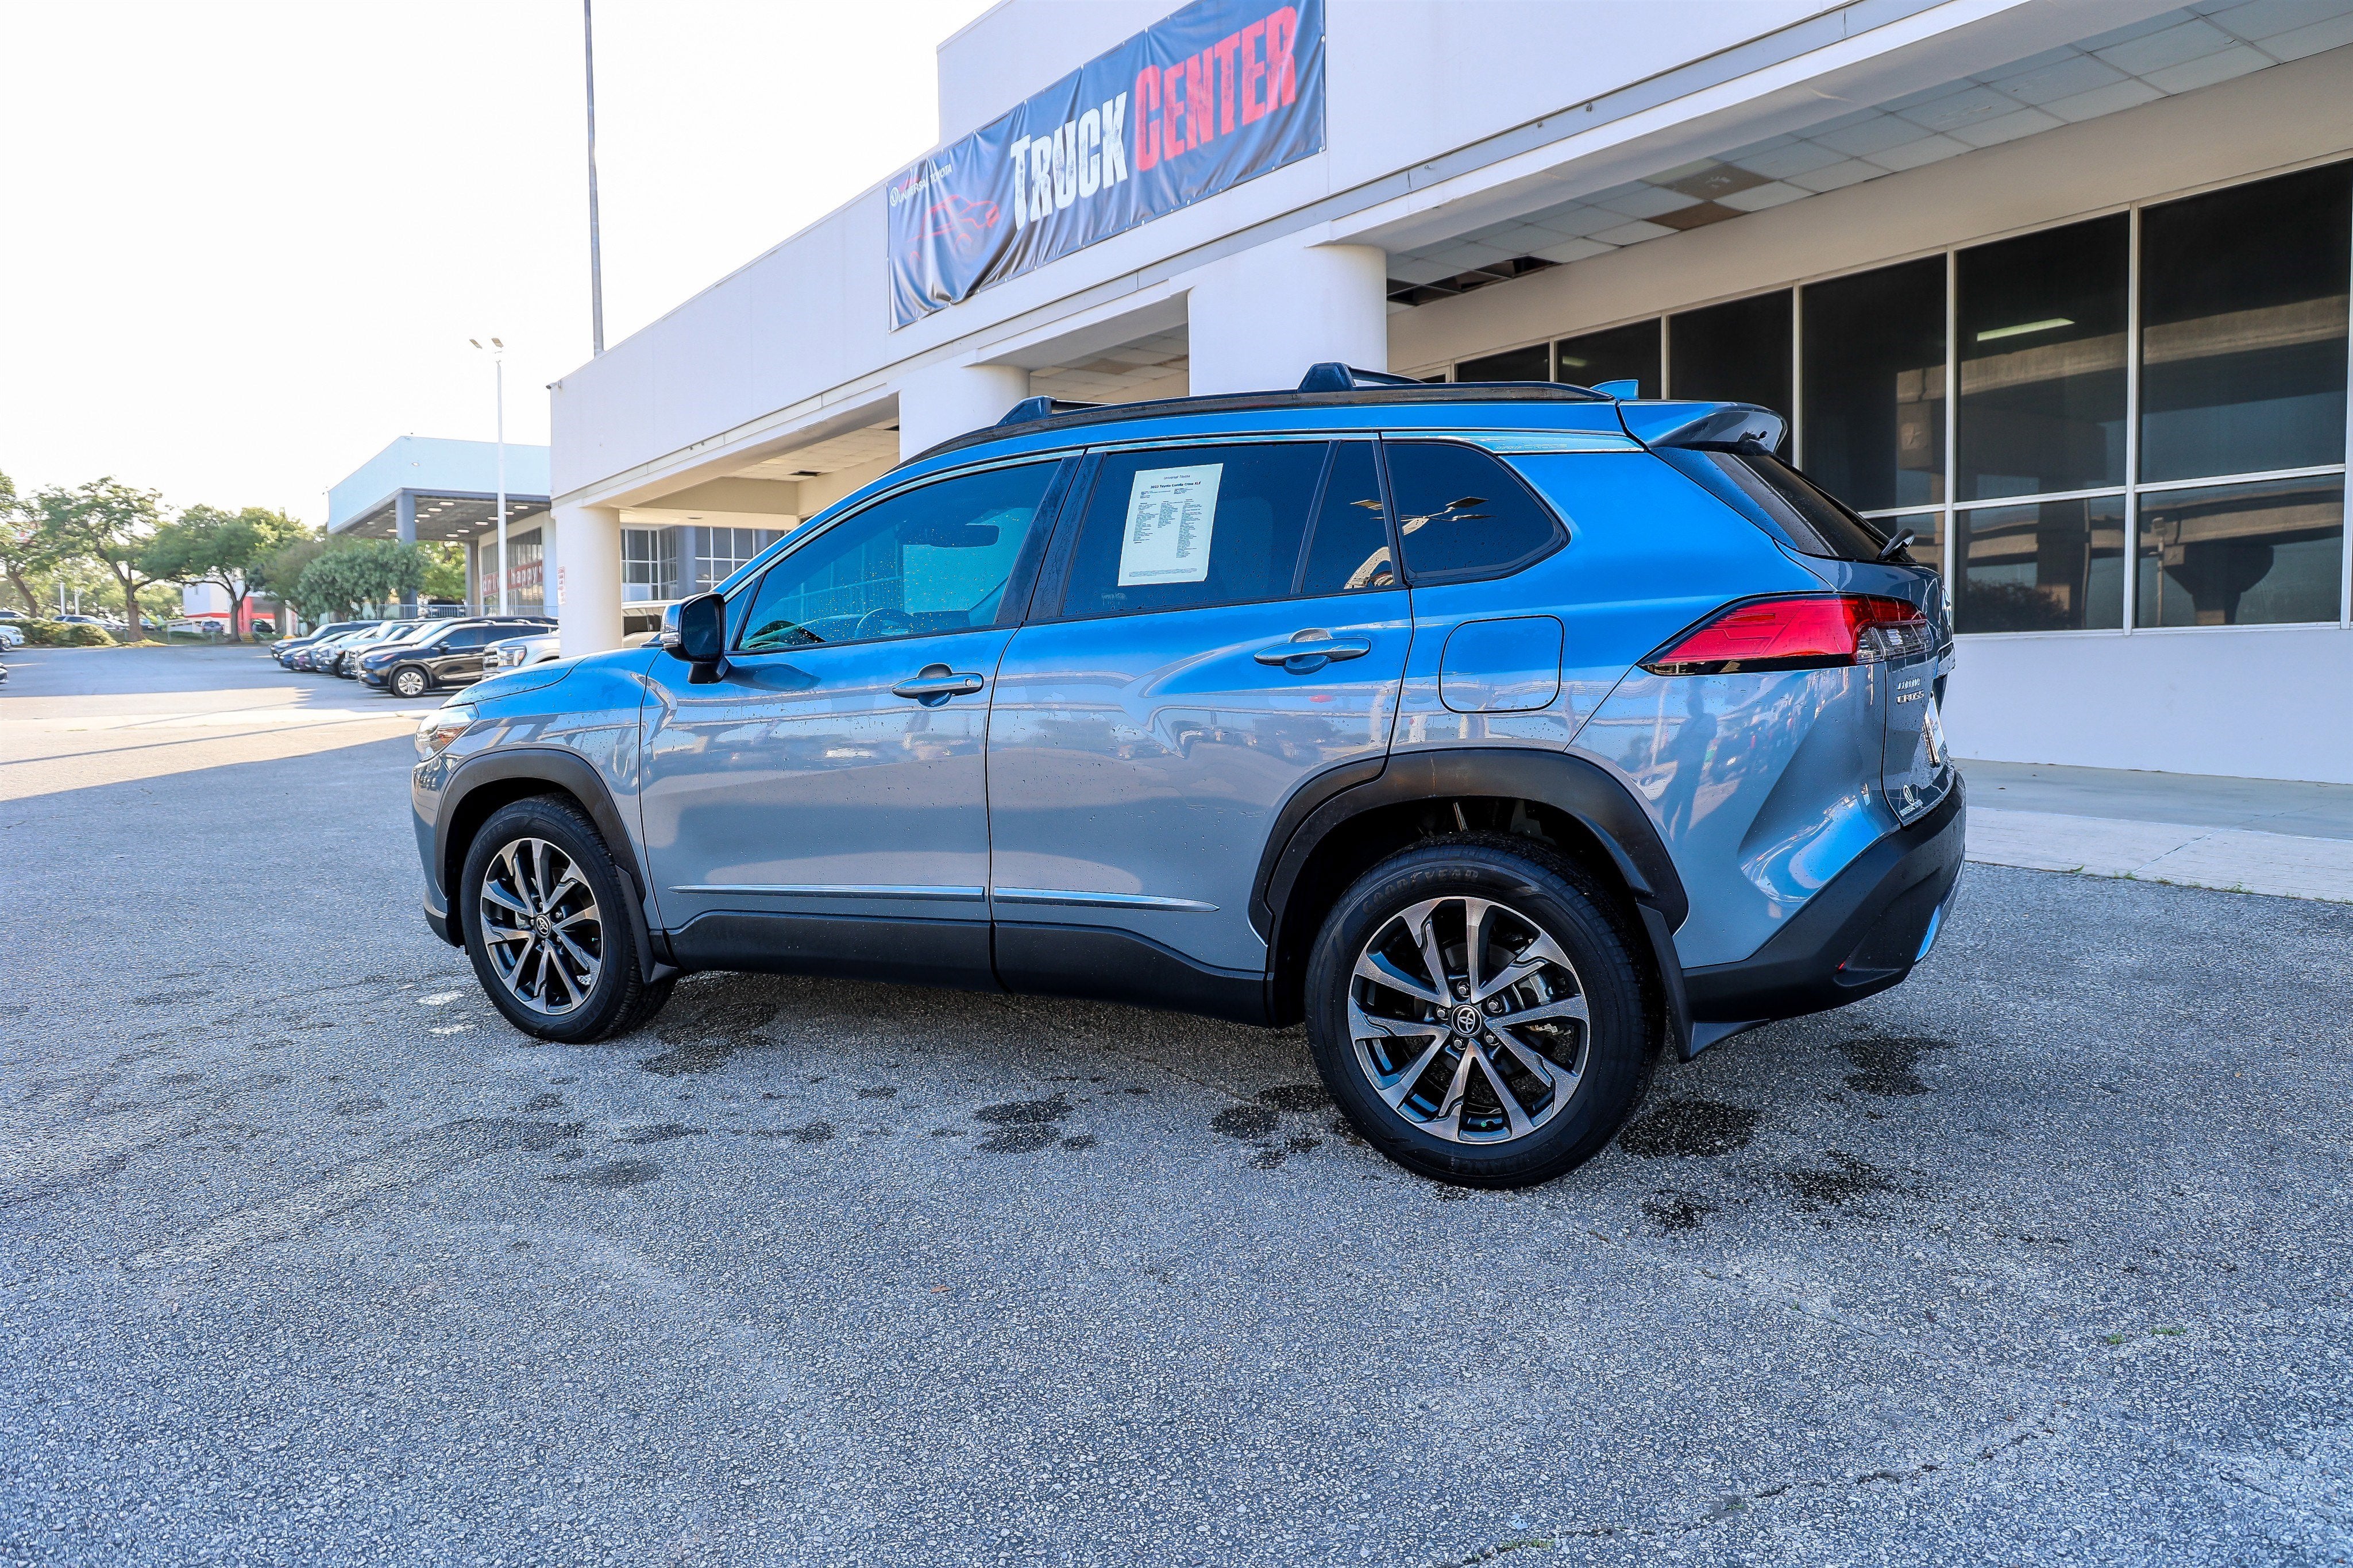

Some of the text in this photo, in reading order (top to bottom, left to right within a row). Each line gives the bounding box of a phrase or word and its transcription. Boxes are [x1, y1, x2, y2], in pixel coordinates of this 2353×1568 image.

[1010, 5, 1298, 230] TRUCK CENTER
[929, 163, 953, 184] TOYOTA
[511, 566, 538, 586] happy
